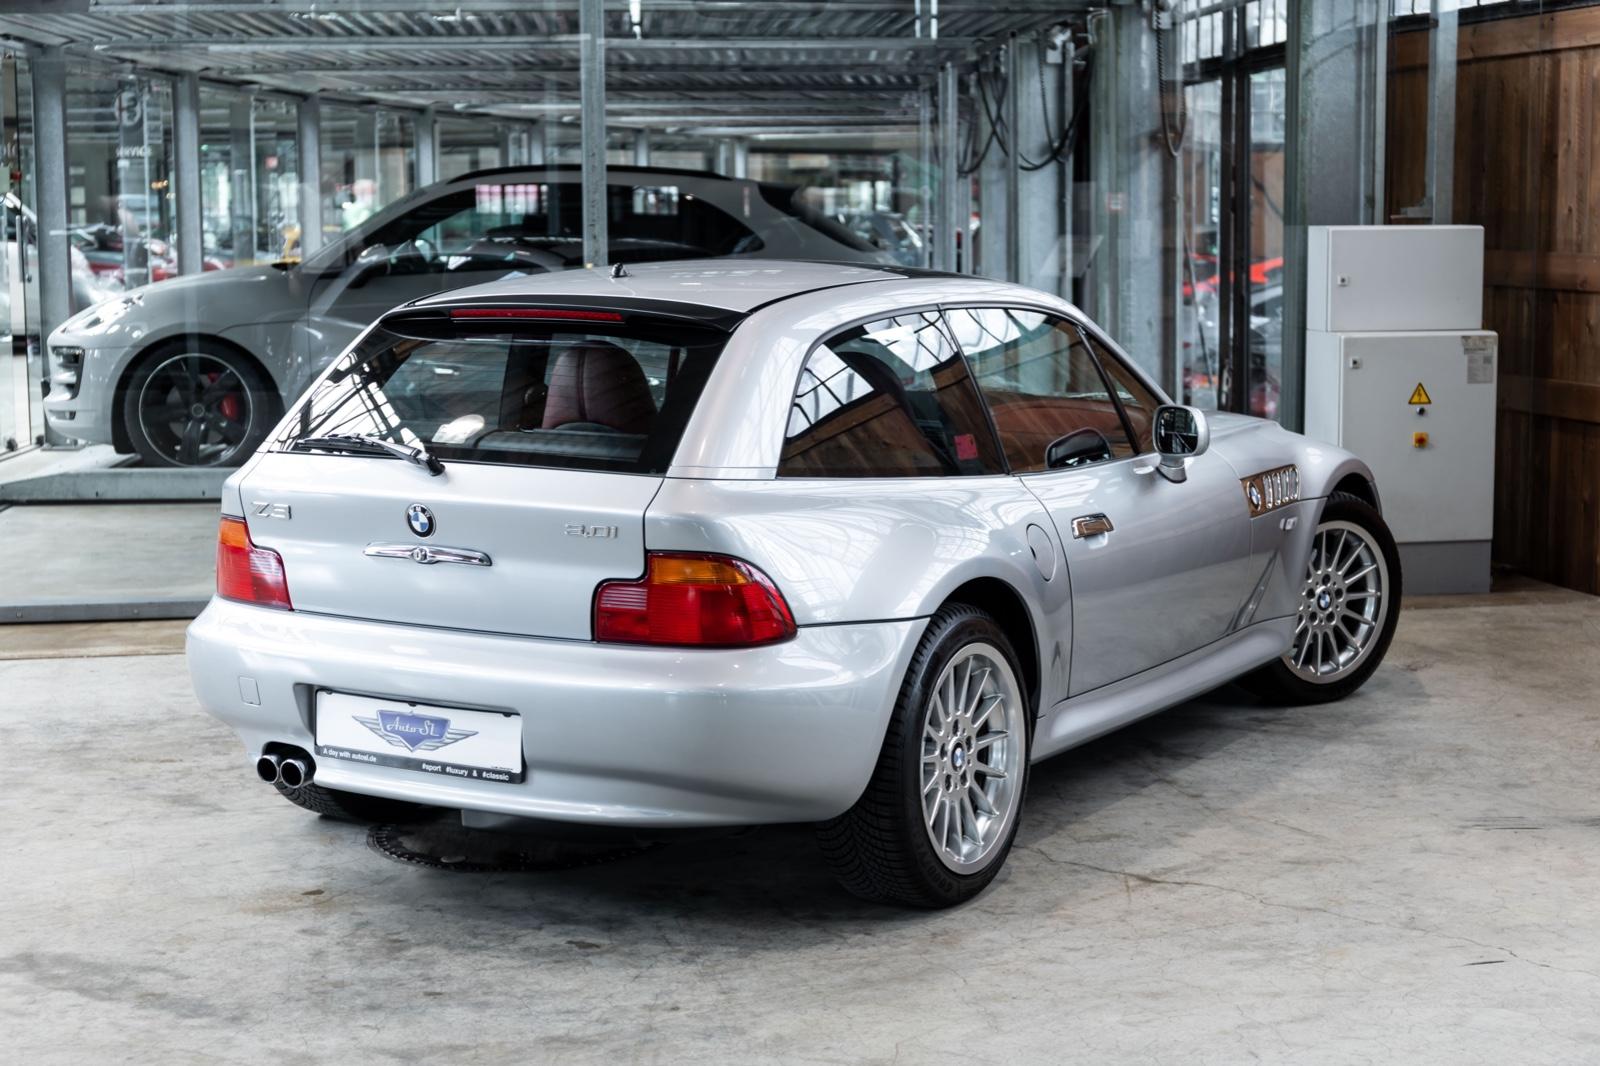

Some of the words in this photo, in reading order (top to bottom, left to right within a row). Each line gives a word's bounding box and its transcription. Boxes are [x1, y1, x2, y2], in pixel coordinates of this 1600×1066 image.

[250, 501, 292, 520] Z3
[386, 716, 418, 733] Auto
[328, 749, 339, 758] day
[471, 769, 479, 777] &
